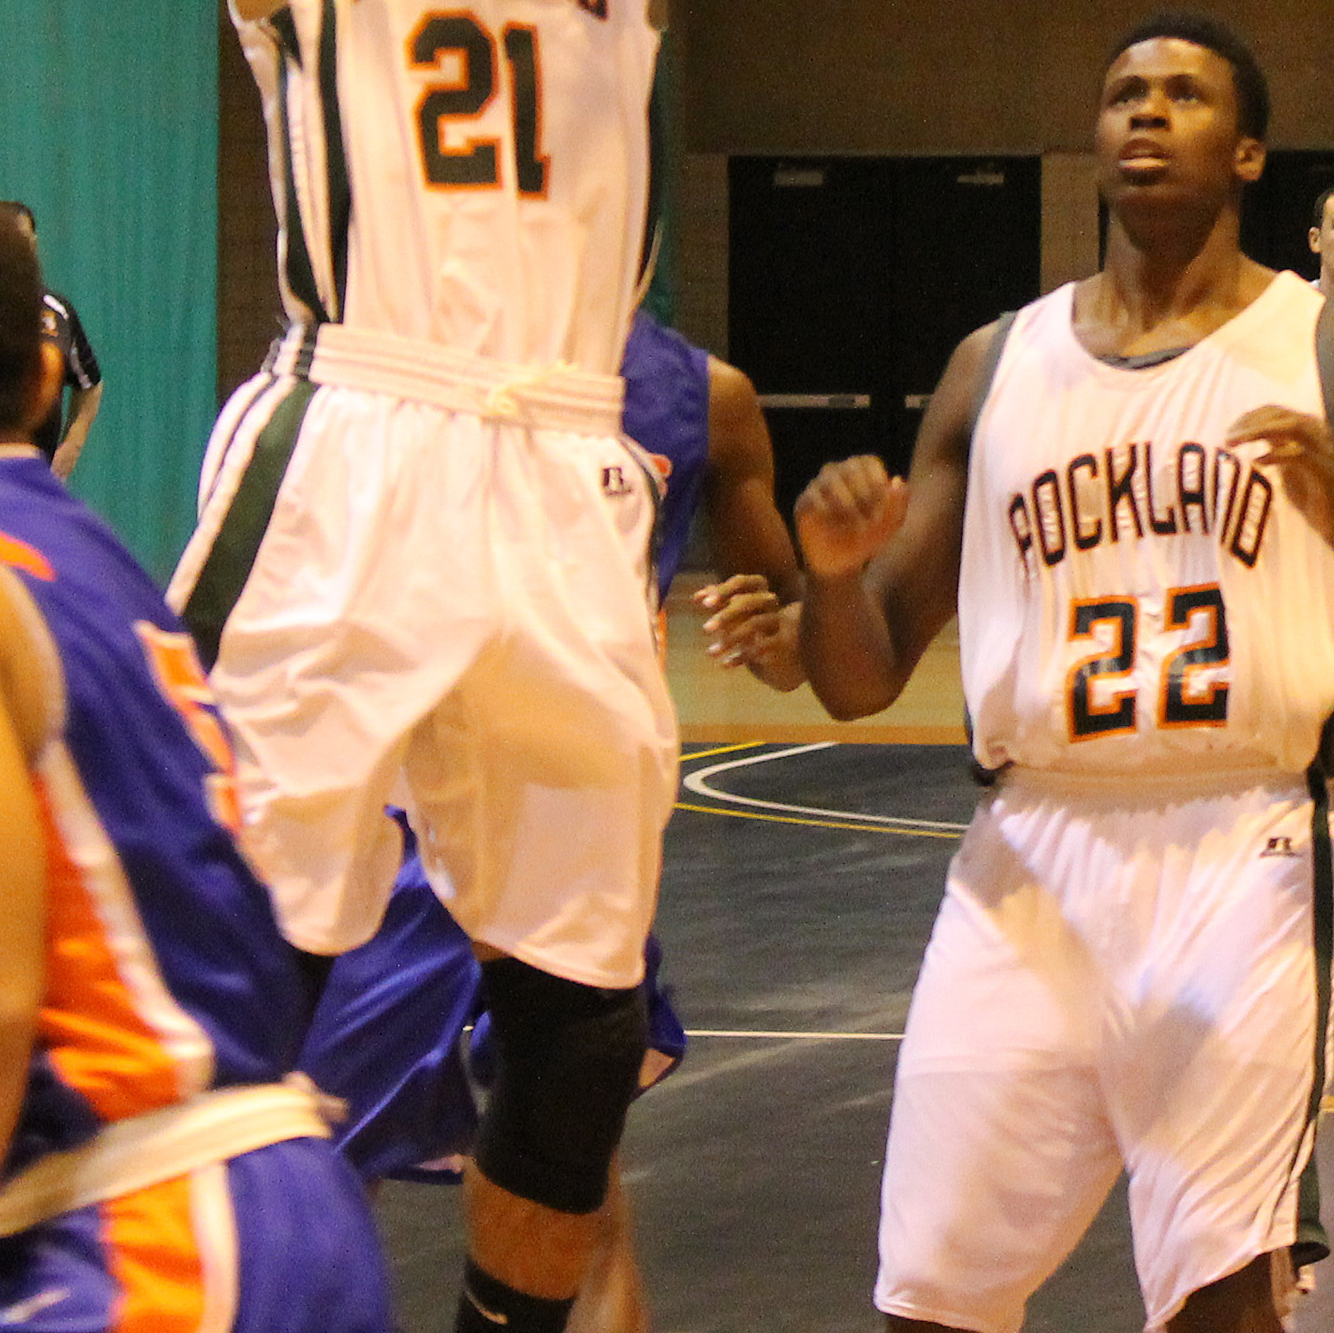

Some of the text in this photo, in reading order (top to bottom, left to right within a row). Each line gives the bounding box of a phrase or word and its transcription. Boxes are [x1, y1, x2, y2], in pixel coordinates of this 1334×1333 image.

[404, 9, 552, 202] 21
[1008, 441, 1273, 569] ROCKLAND
[1067, 582, 1230, 743] 22
